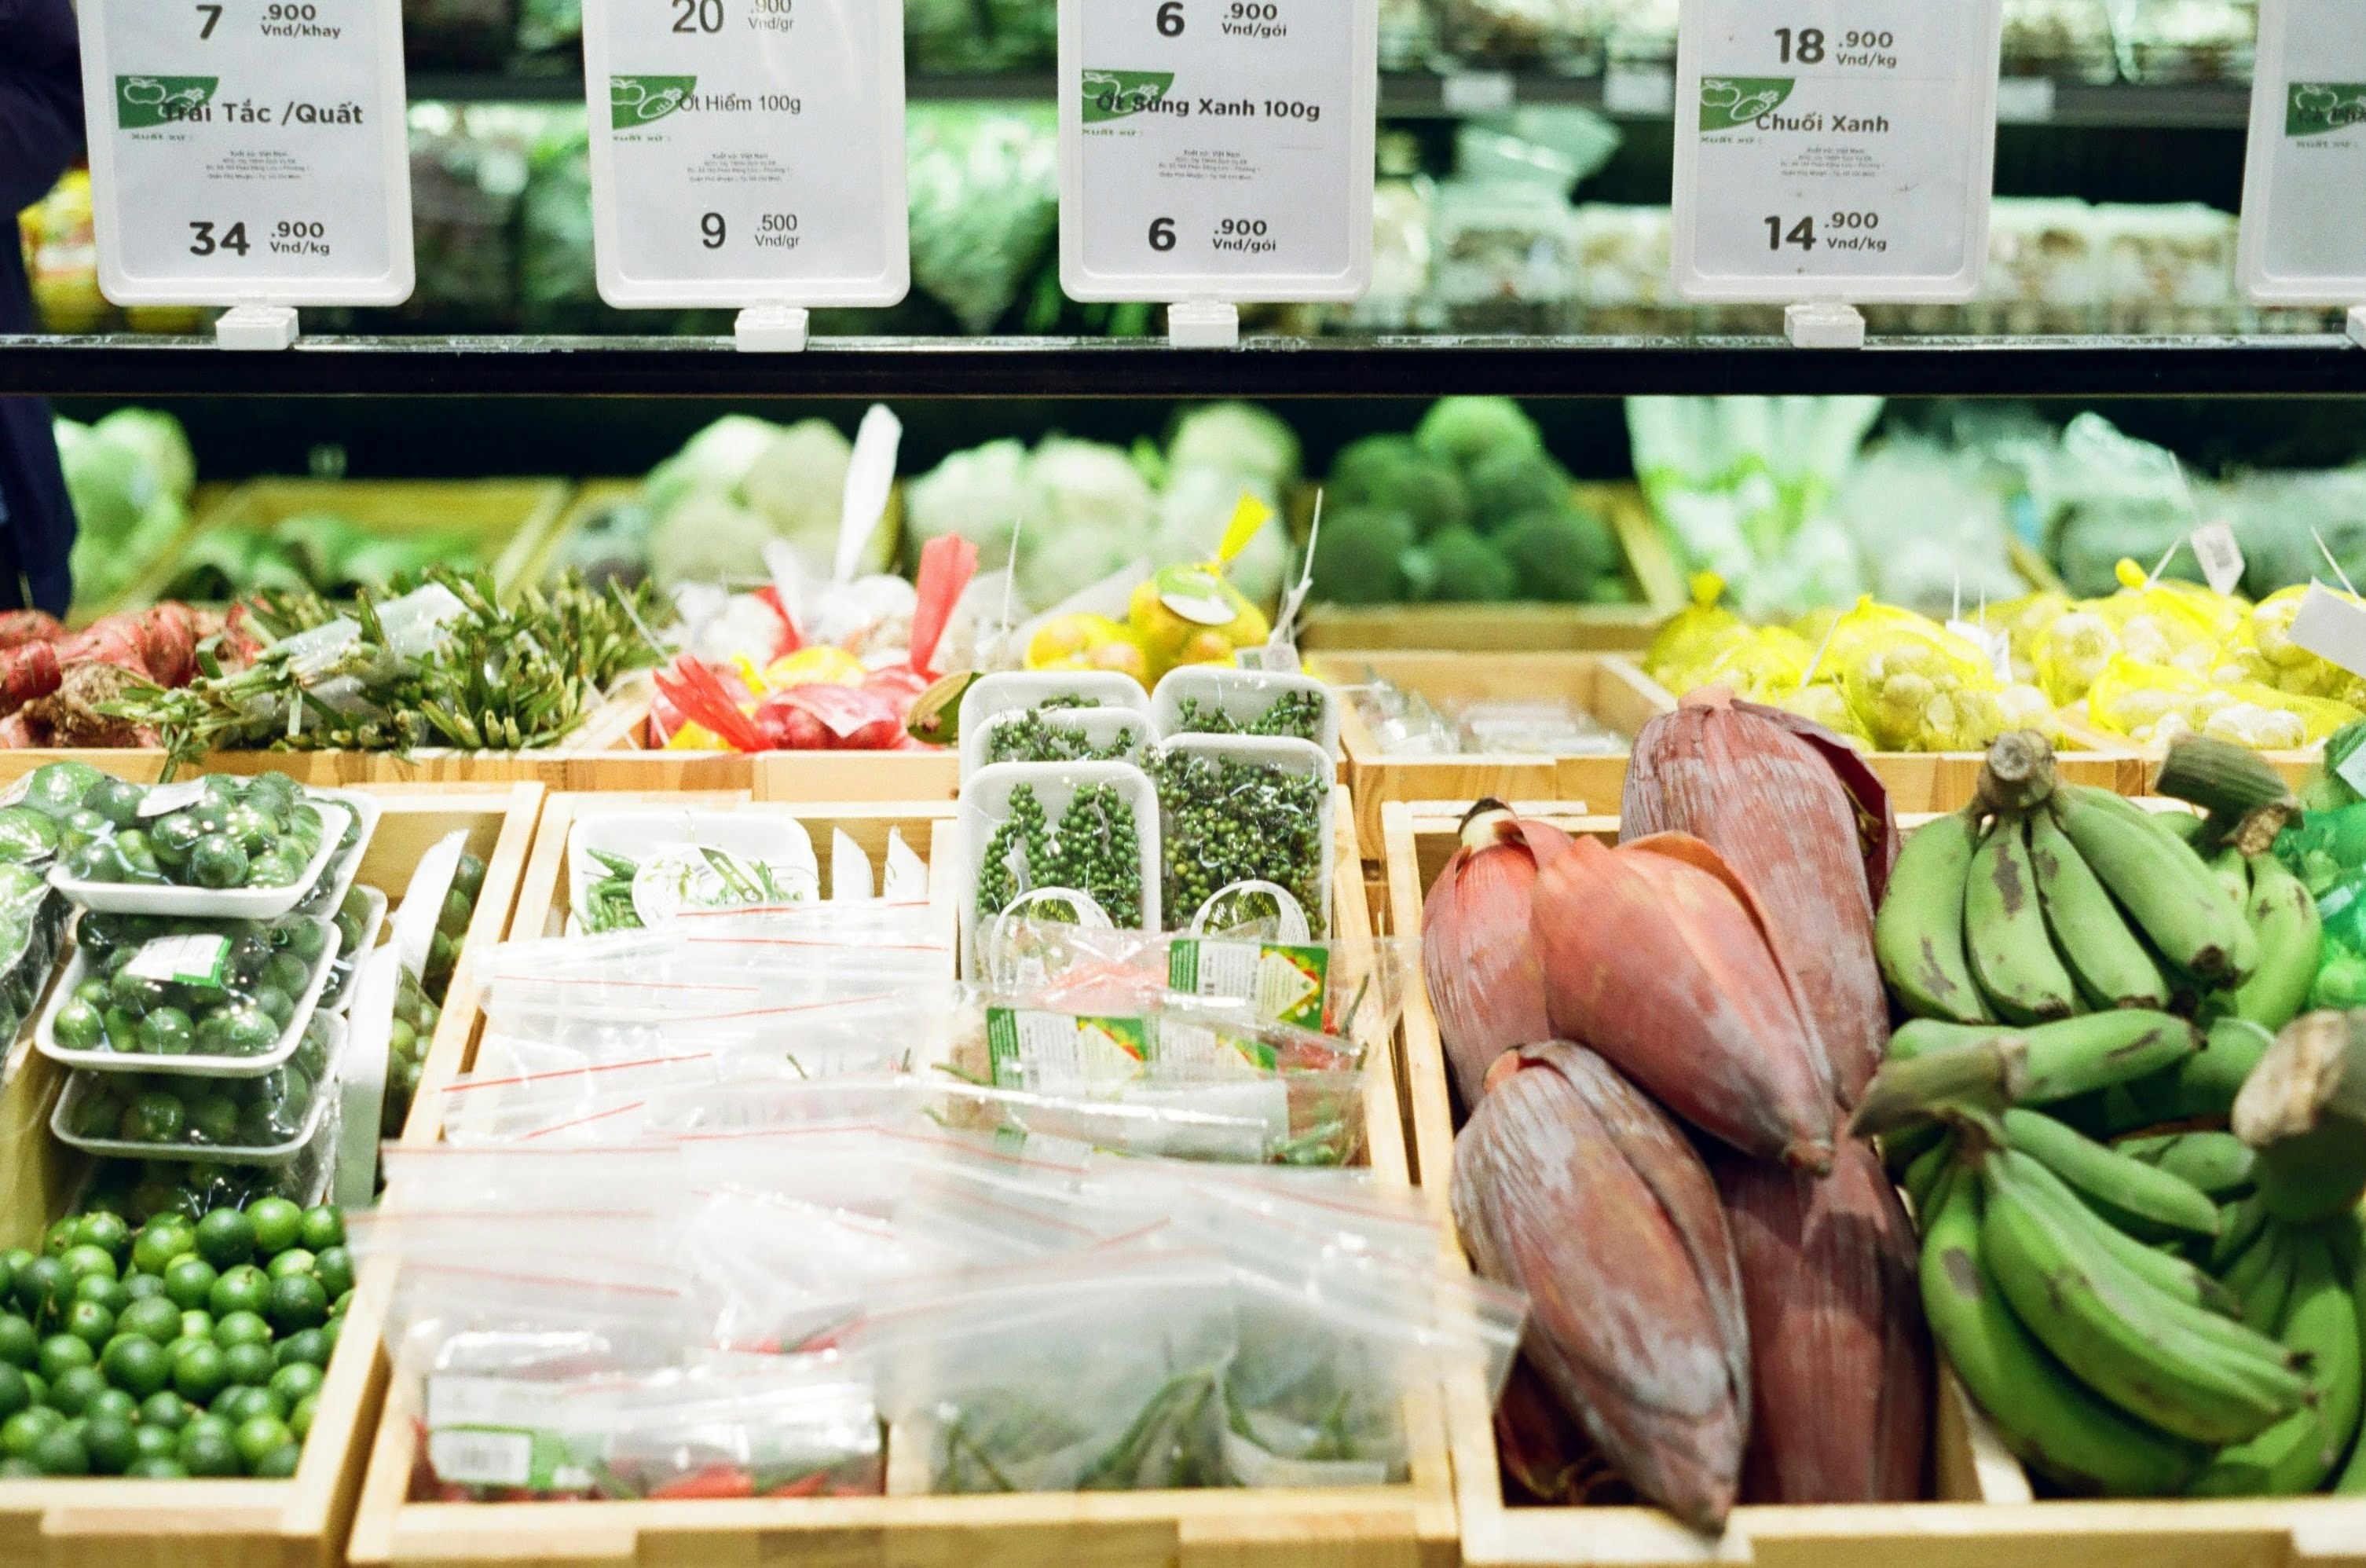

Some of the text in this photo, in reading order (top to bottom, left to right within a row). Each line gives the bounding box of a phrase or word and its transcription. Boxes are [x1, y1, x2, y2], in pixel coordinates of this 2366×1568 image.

[196, 3, 317, 40] 7 .900
[672, 0, 724, 34] 20
[747, 16, 794, 33] Vnd/gr
[1156, 1, 1278, 38] 6 .900
[260, 23, 341, 39] Vnd/khay
[1221, 22, 1287, 38] Vnd/gói
[1774, 27, 1894, 64] 18 .900
[1836, 52, 1897, 69] Vnd/kg
[222, 98, 271, 123] Tắc
[759, 95, 801, 115] 100g
[1198, 97, 1255, 117] Xanh
[1264, 100, 1320, 123] 100g
[1756, 112, 1889, 133] Chuối Xanh
[189, 221, 325, 257] 34 .900
[701, 211, 798, 250] 9 .500
[754, 234, 800, 250] Vnd/gr
[1148, 216, 1268, 252] 6 .900
[1764, 211, 1879, 251] 14 .900
[269, 240, 331, 257] Vnd/kg
[1212, 237, 1276, 254] Vnd/gói
[1826, 236, 1888, 252] Vnd/kg
